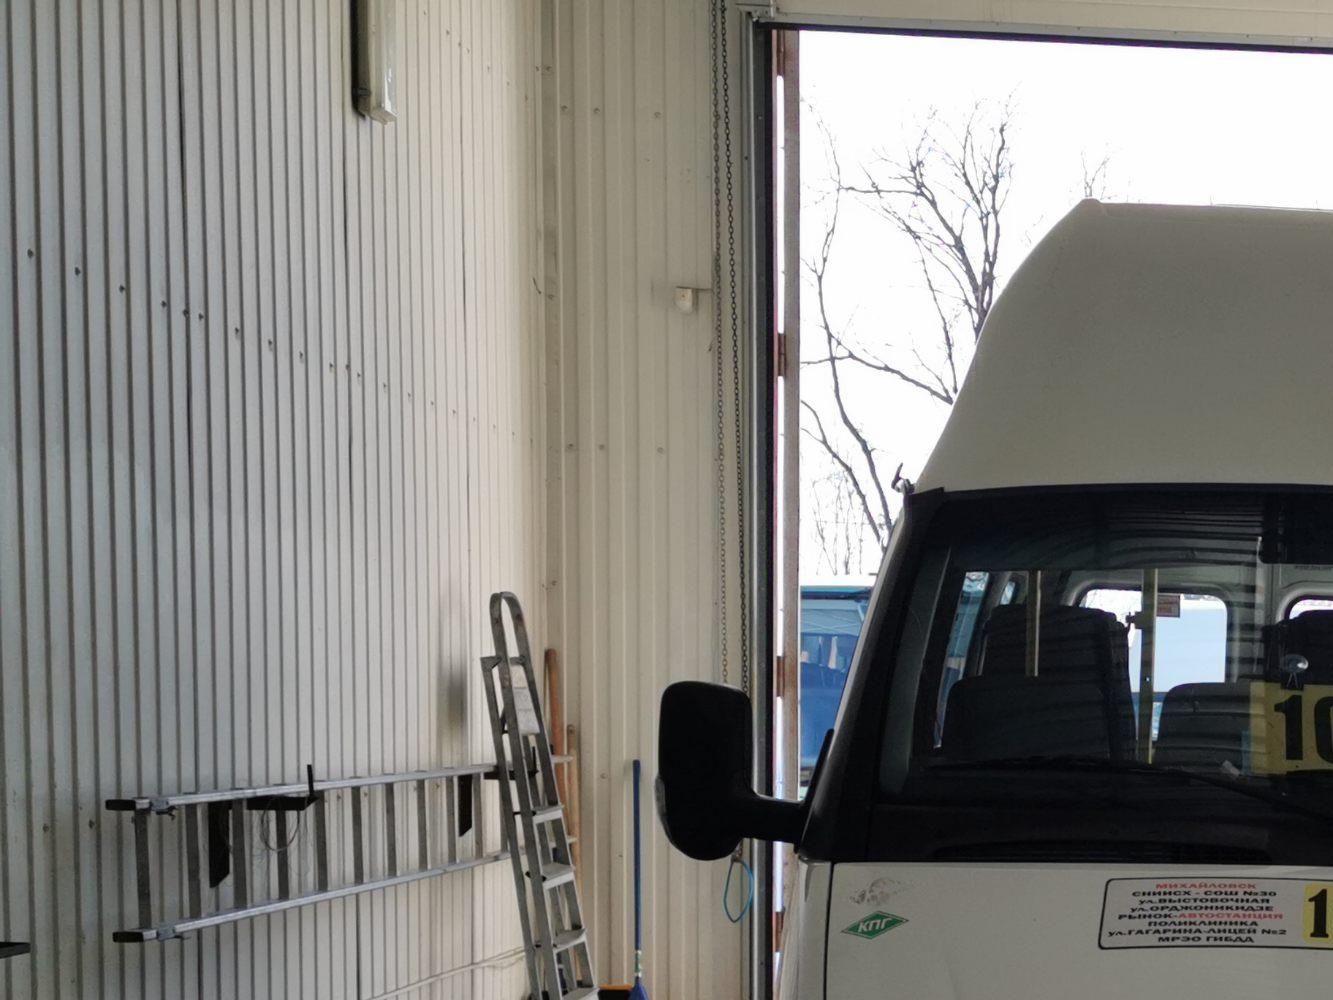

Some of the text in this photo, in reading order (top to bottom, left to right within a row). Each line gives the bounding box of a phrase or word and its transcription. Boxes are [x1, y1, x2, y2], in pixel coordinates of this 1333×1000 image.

[1156, 882, 1257, 890] МИХАЙЛОВСК
[858, 917, 893, 933] КПГ
[1147, 920, 1259, 928] ПОЛИКЛИНИКА
[1206, 936, 1255, 944] ГИБДД
